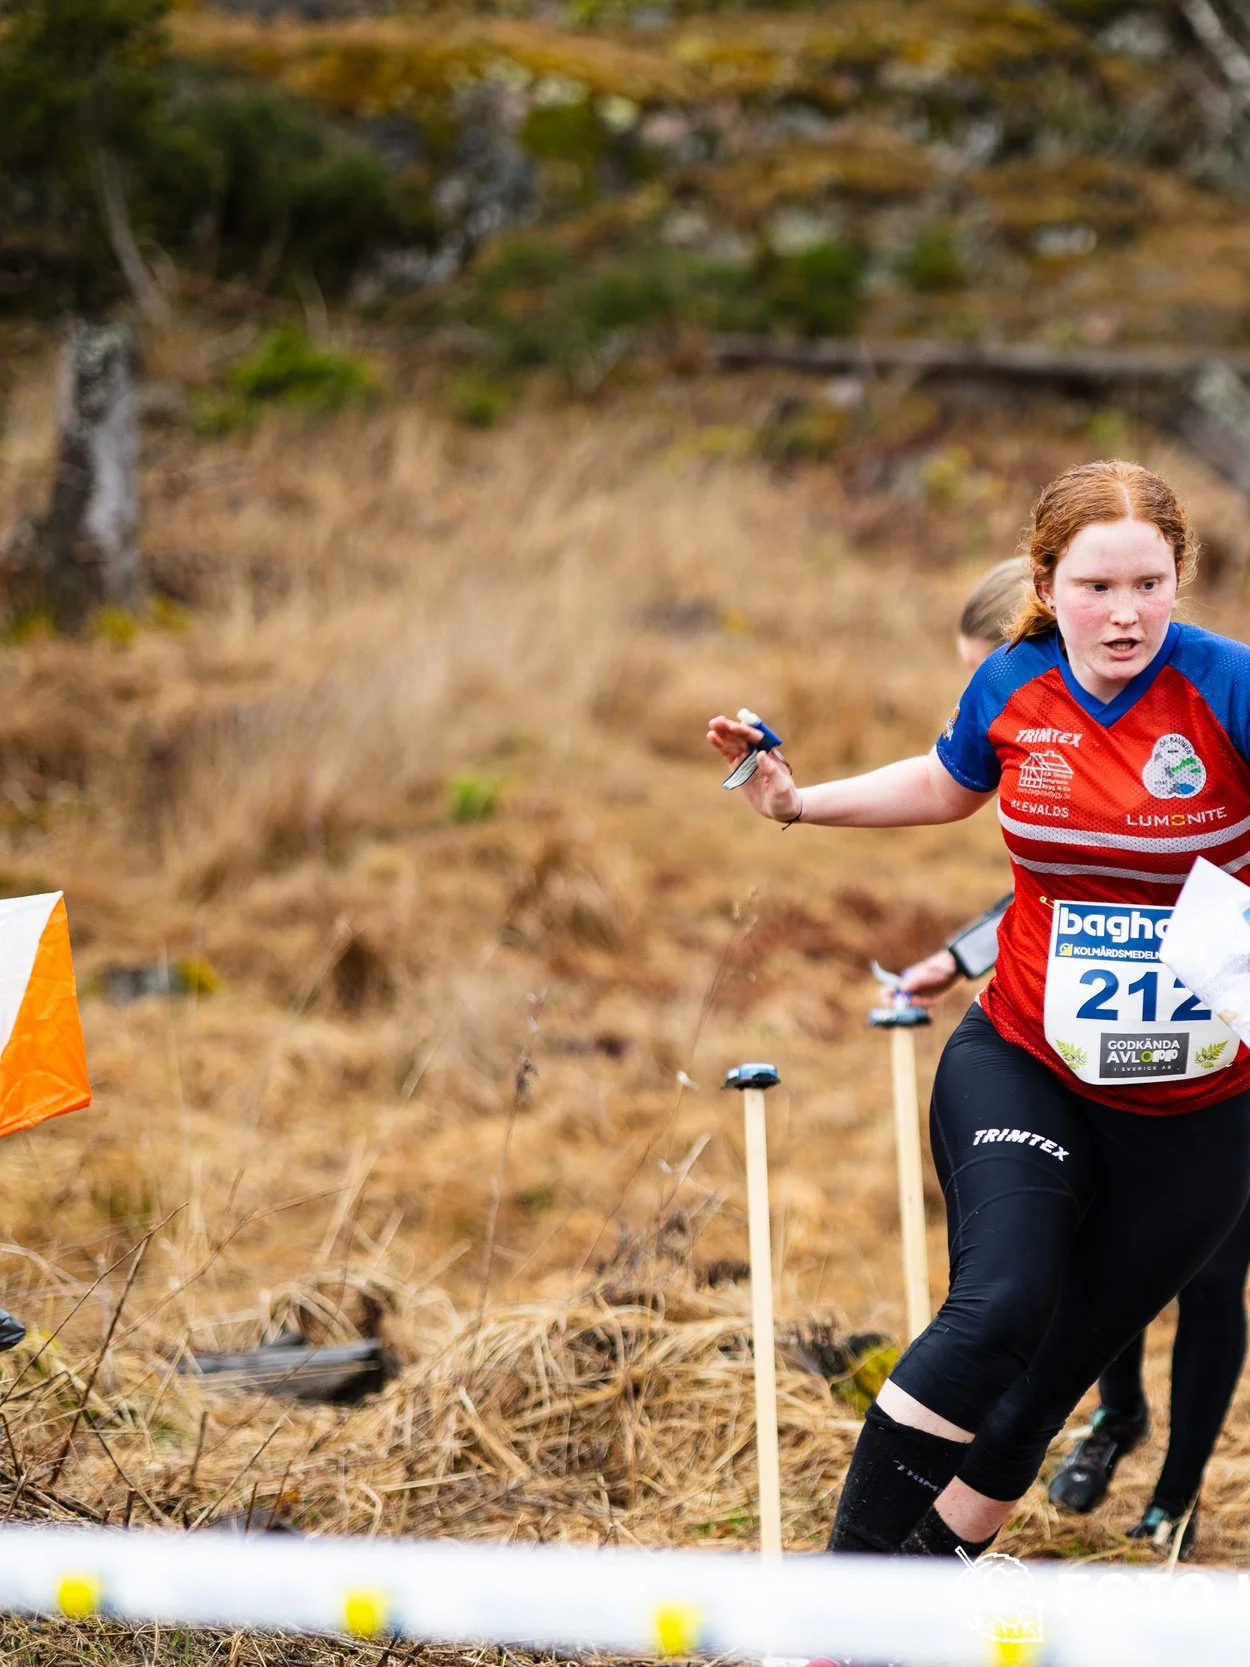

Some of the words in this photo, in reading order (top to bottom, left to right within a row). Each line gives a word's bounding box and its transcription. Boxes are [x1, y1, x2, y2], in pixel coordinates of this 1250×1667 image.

[1015, 727, 1083, 748] TRIMTEX
[1126, 806, 1227, 827] LUMONITE
[1107, 1038, 1180, 1050] GODKÄNDA
[973, 1129, 1070, 1162] TRIMTEX
